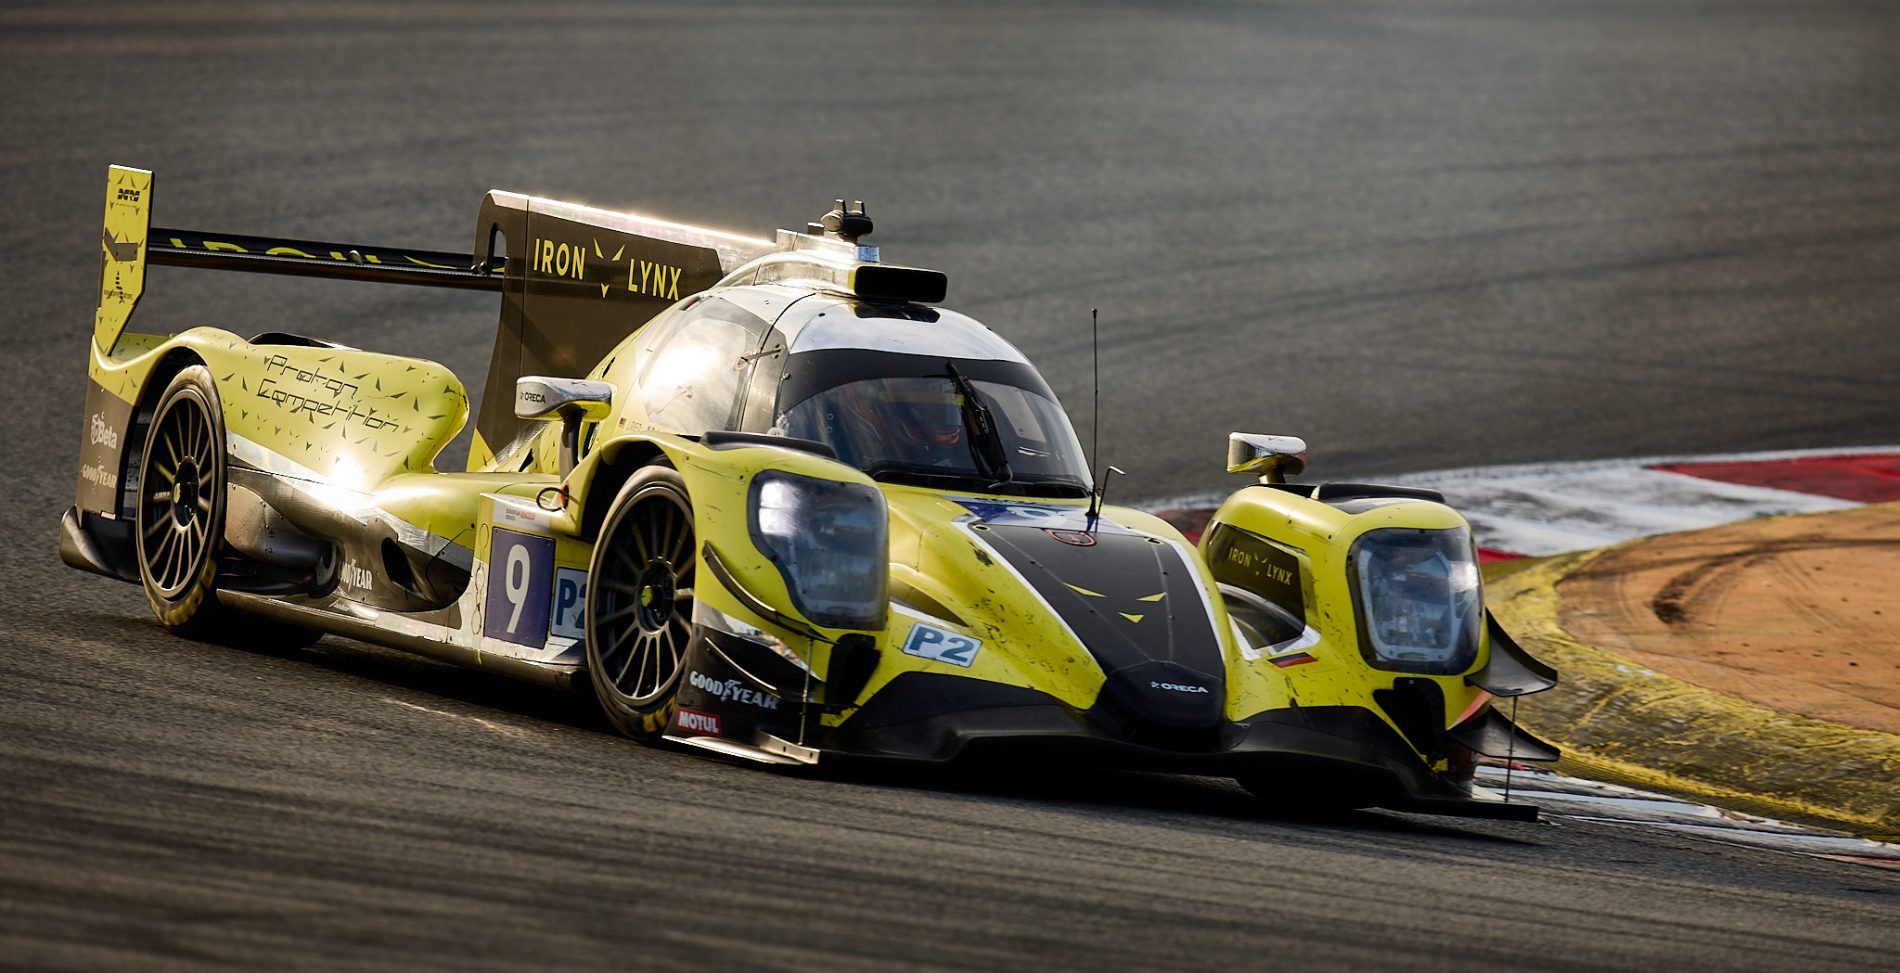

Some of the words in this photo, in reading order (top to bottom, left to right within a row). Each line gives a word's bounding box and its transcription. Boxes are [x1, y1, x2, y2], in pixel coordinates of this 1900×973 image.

[533, 238, 586, 280] IRON
[628, 258, 682, 301] LYNX
[266, 354, 358, 399] Proton
[256, 378, 400, 432] Competition
[524, 391, 546, 404] ORECA
[99, 419, 118, 449] Beta
[1228, 546, 1251, 567] IRON
[1266, 563, 1293, 586] LYNX
[506, 544, 531, 634] 9
[909, 626, 974, 663] P2
[1160, 682, 1209, 694] ORECA
[677, 710, 720, 734] MOTUL
